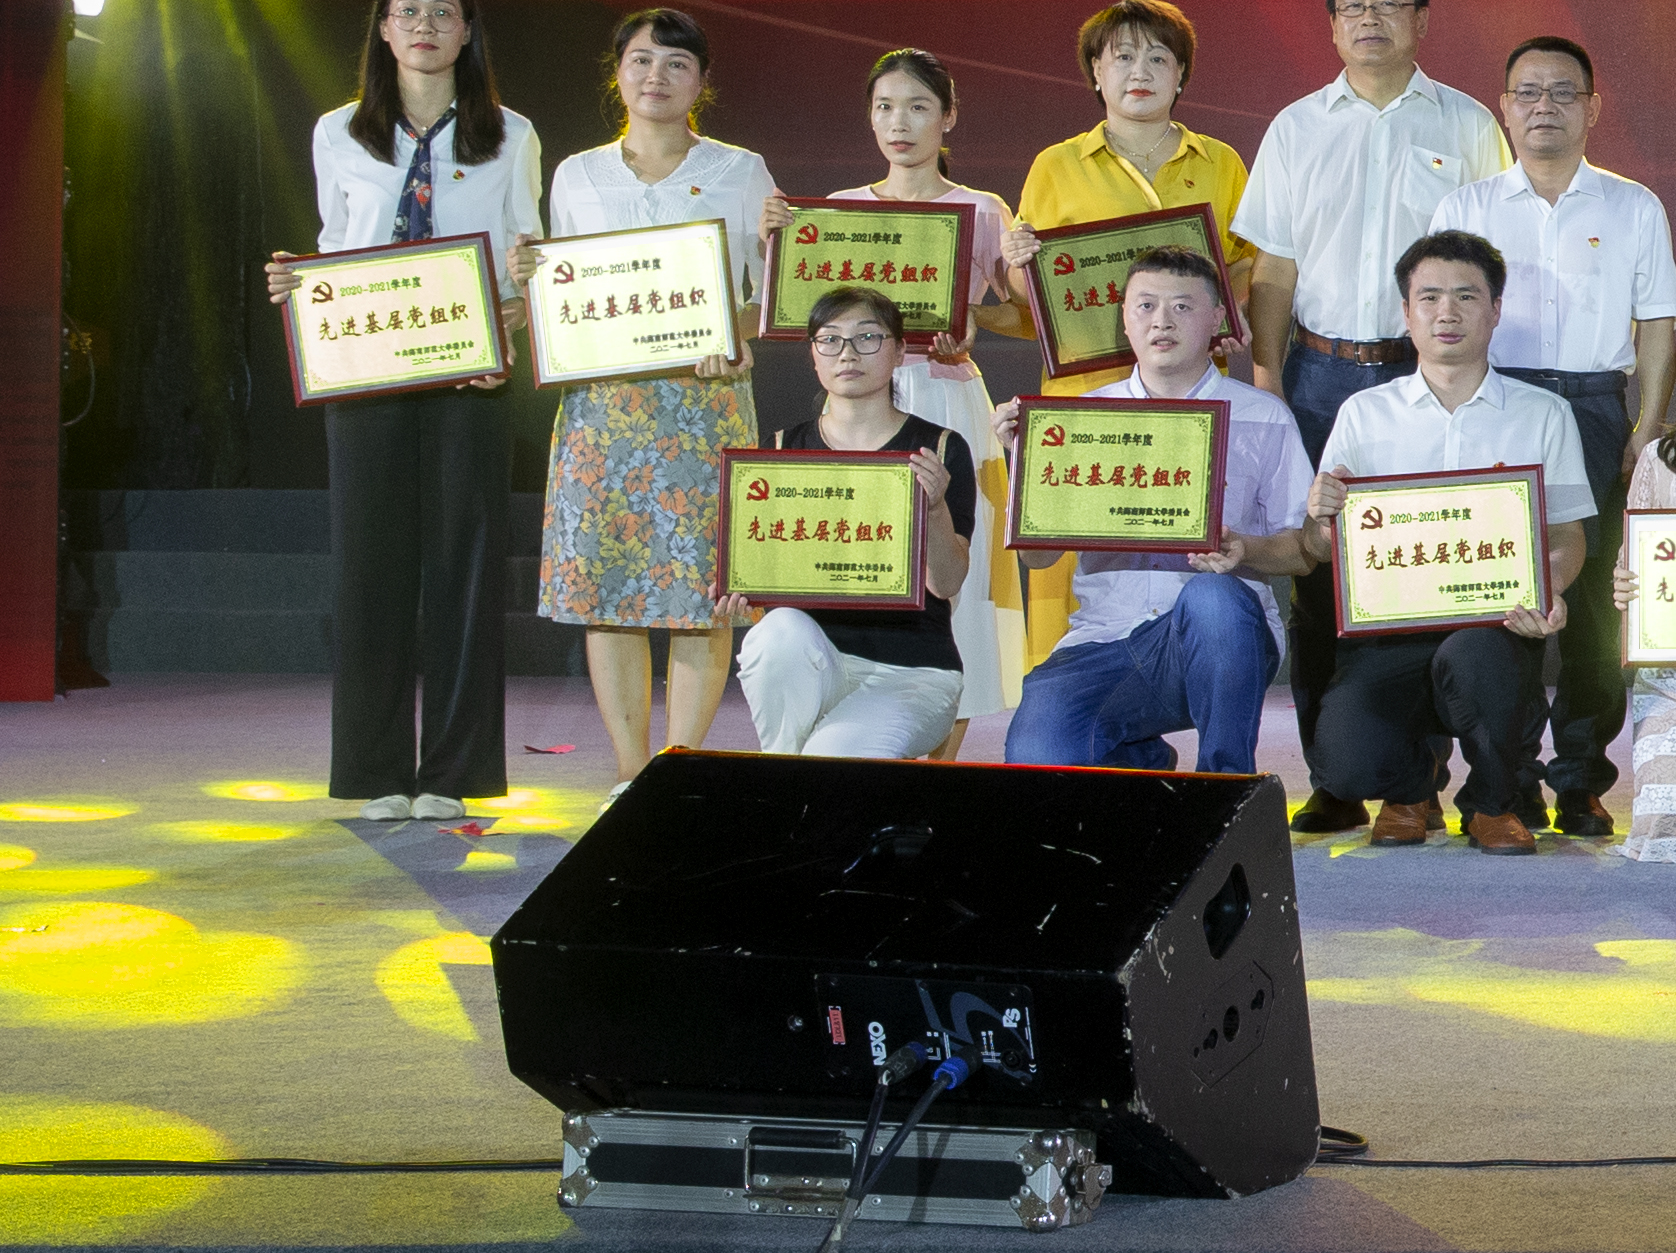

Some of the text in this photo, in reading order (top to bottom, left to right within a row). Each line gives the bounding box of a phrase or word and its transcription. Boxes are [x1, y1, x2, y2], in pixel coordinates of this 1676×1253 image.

[823, 231, 903, 245] 2020-2021学年度
[581, 257, 662, 278] 2020-2021学年度
[1080, 246, 1152, 269] 2020-2021学
[794, 257, 938, 284] 先进基层党组织
[340, 276, 422, 297] 2020-2021学年度
[560, 287, 708, 324] 先进基层党组织
[319, 302, 469, 340] 先进基层党组织
[1071, 433, 1153, 446] 2020-2021学年度
[1041, 461, 1192, 488] 先进基层党组织
[775, 486, 855, 500] 2020-2021学年度
[1390, 508, 1472, 525] 2020-2021学年度
[747, 516, 893, 543] 先进基层党组织
[1366, 538, 1516, 571] 先进基层党组织
[867, 1021, 887, 1066] NEXO
